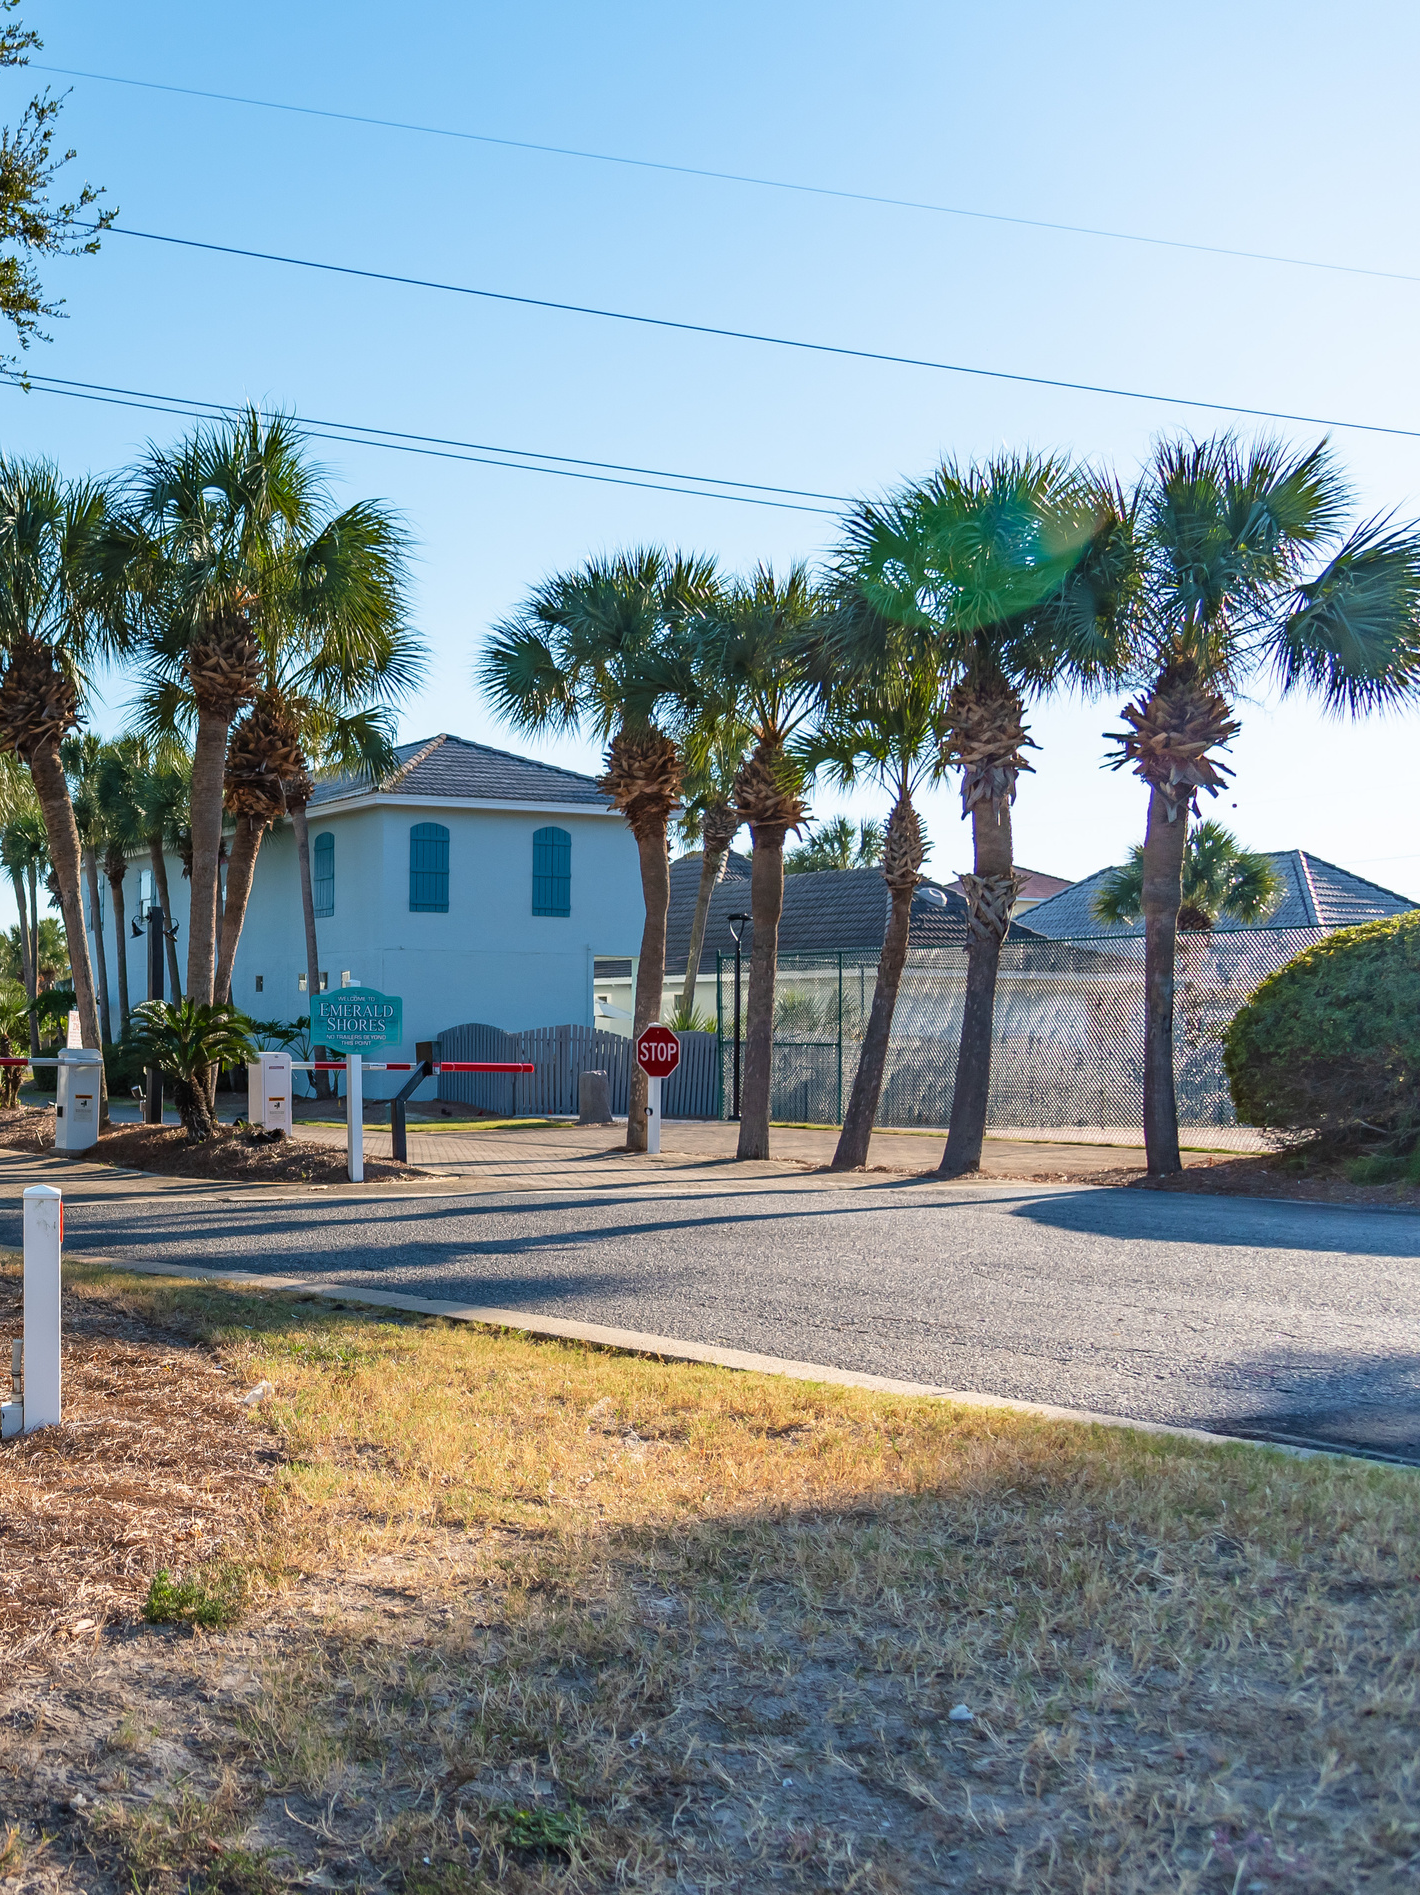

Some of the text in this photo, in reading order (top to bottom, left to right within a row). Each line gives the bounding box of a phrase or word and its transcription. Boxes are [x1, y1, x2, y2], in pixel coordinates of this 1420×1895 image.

[320, 1002, 394, 1018] EMERALD
[327, 1017, 386, 1032] SHORES
[640, 1042, 677, 1061] STOP
